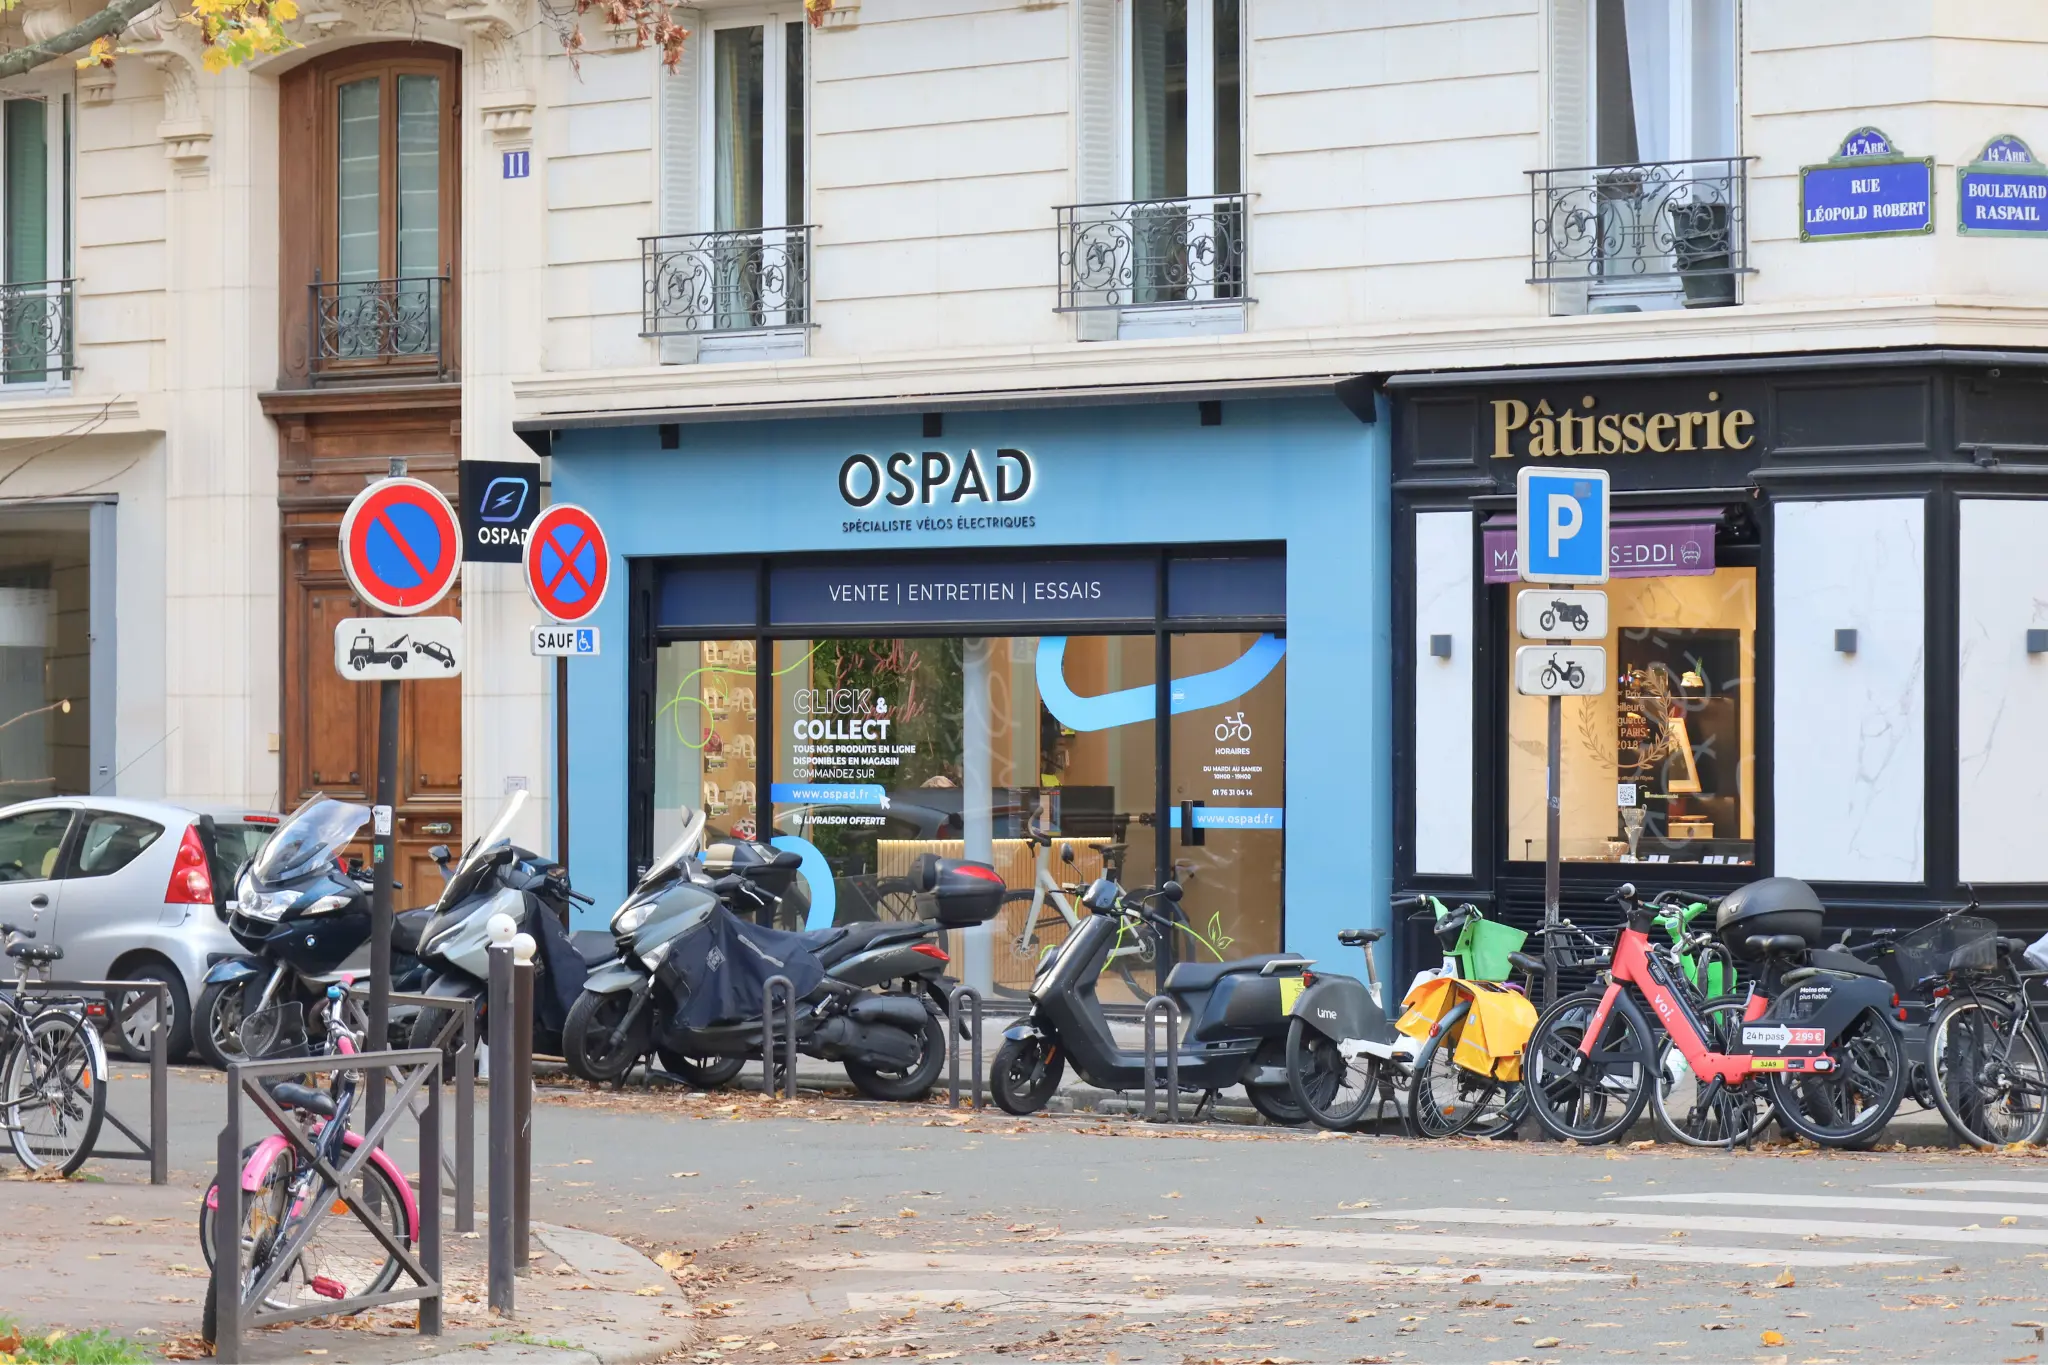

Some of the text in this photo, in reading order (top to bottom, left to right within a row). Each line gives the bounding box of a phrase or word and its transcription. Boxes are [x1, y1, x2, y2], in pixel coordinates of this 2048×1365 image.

[1851, 178, 1880, 194] RUE
[1968, 183, 2047, 199] BOULEVARD
[1807, 201, 1926, 223] LÉOPOLD ROBERT
[1976, 205, 2040, 221] RASPAIL
[1490, 391, 1755, 458] Pâtisserie
[839, 449, 1032, 507] OSPAD
[843, 515, 1036, 533] SPÉCIALISTE VÉLOS ÉLECTRIQUES
[1548, 493, 1583, 558] P
[829, 584, 889, 602] VENTE
[908, 583, 1014, 601] ENTRETIEN
[1035, 581, 1101, 600] ESSAIS
[538, 633, 573, 648] SAUF
[793, 688, 872, 714] CLICK
[876, 697, 888, 713] &
[1625, 690, 1642, 699] Prix
[1614, 702, 1646, 711] eilleure
[1607, 716, 1646, 726] Bguette
[793, 719, 891, 740] COLLECT
[1620, 728, 1646, 737] PARIS
[793, 745, 916, 753] TOUS NOS PRODUITS EN LIGNE
[1616, 740, 1639, 750] 2018
[793, 757, 899, 765] DISPONIBLES EN MAGASIN
[793, 769, 875, 778] COMMANDEZ SUR
[793, 788, 868, 801] www.ospad.fr
[804, 816, 886, 825] LIVRAISON OFFERTE
[1197, 813, 1274, 827] www.ospad.fr
[1654, 994, 1674, 1022] voi.
[1746, 1031, 1785, 1042] 24 h pass
